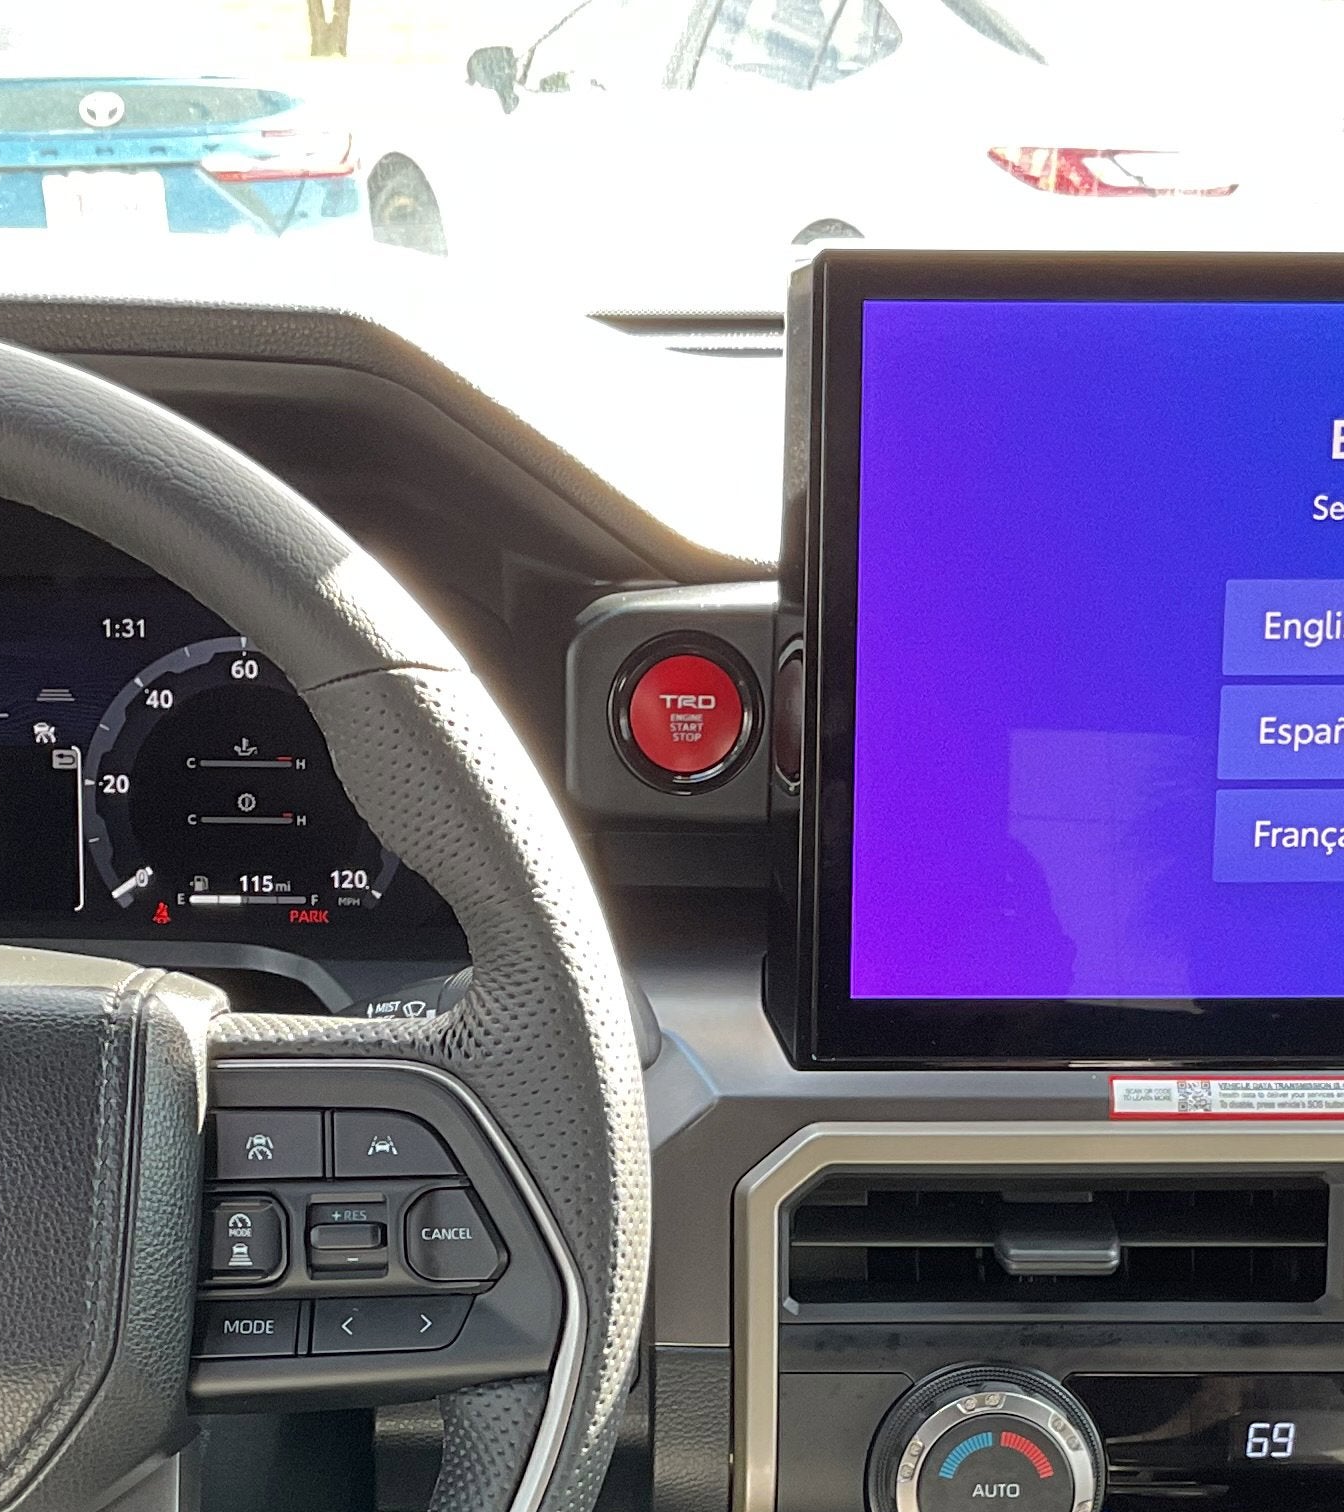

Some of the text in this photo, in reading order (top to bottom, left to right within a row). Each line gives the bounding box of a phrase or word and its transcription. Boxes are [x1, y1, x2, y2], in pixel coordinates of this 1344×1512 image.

[102, 619, 146, 639] 1:31
[231, 660, 258, 679] 60
[146, 690, 173, 709] 40
[659, 694, 716, 709] TRD
[670, 714, 703, 722] ENGINE
[670, 723, 703, 732] START
[672, 732, 702, 742] STOP
[186, 757, 197, 769] C
[296, 758, 306, 770] H
[102, 775, 129, 794] 20
[187, 814, 198, 826] C
[296, 815, 307, 827] H
[135, 868, 149, 889] 0
[331, 870, 365, 889] 120
[177, 894, 185, 906] E
[311, 894, 319, 906] F
[338, 896, 360, 907] MPH
[289, 910, 330, 924] PARK
[375, 1001, 401, 1014] MIST
[228, 1228, 252, 1237] MODE
[421, 1227, 472, 1240] CANCEL
[224, 1320, 274, 1334] MODE
[1246, 1423, 1295, 1458] 69
[972, 1483, 1020, 1499] AUTO
